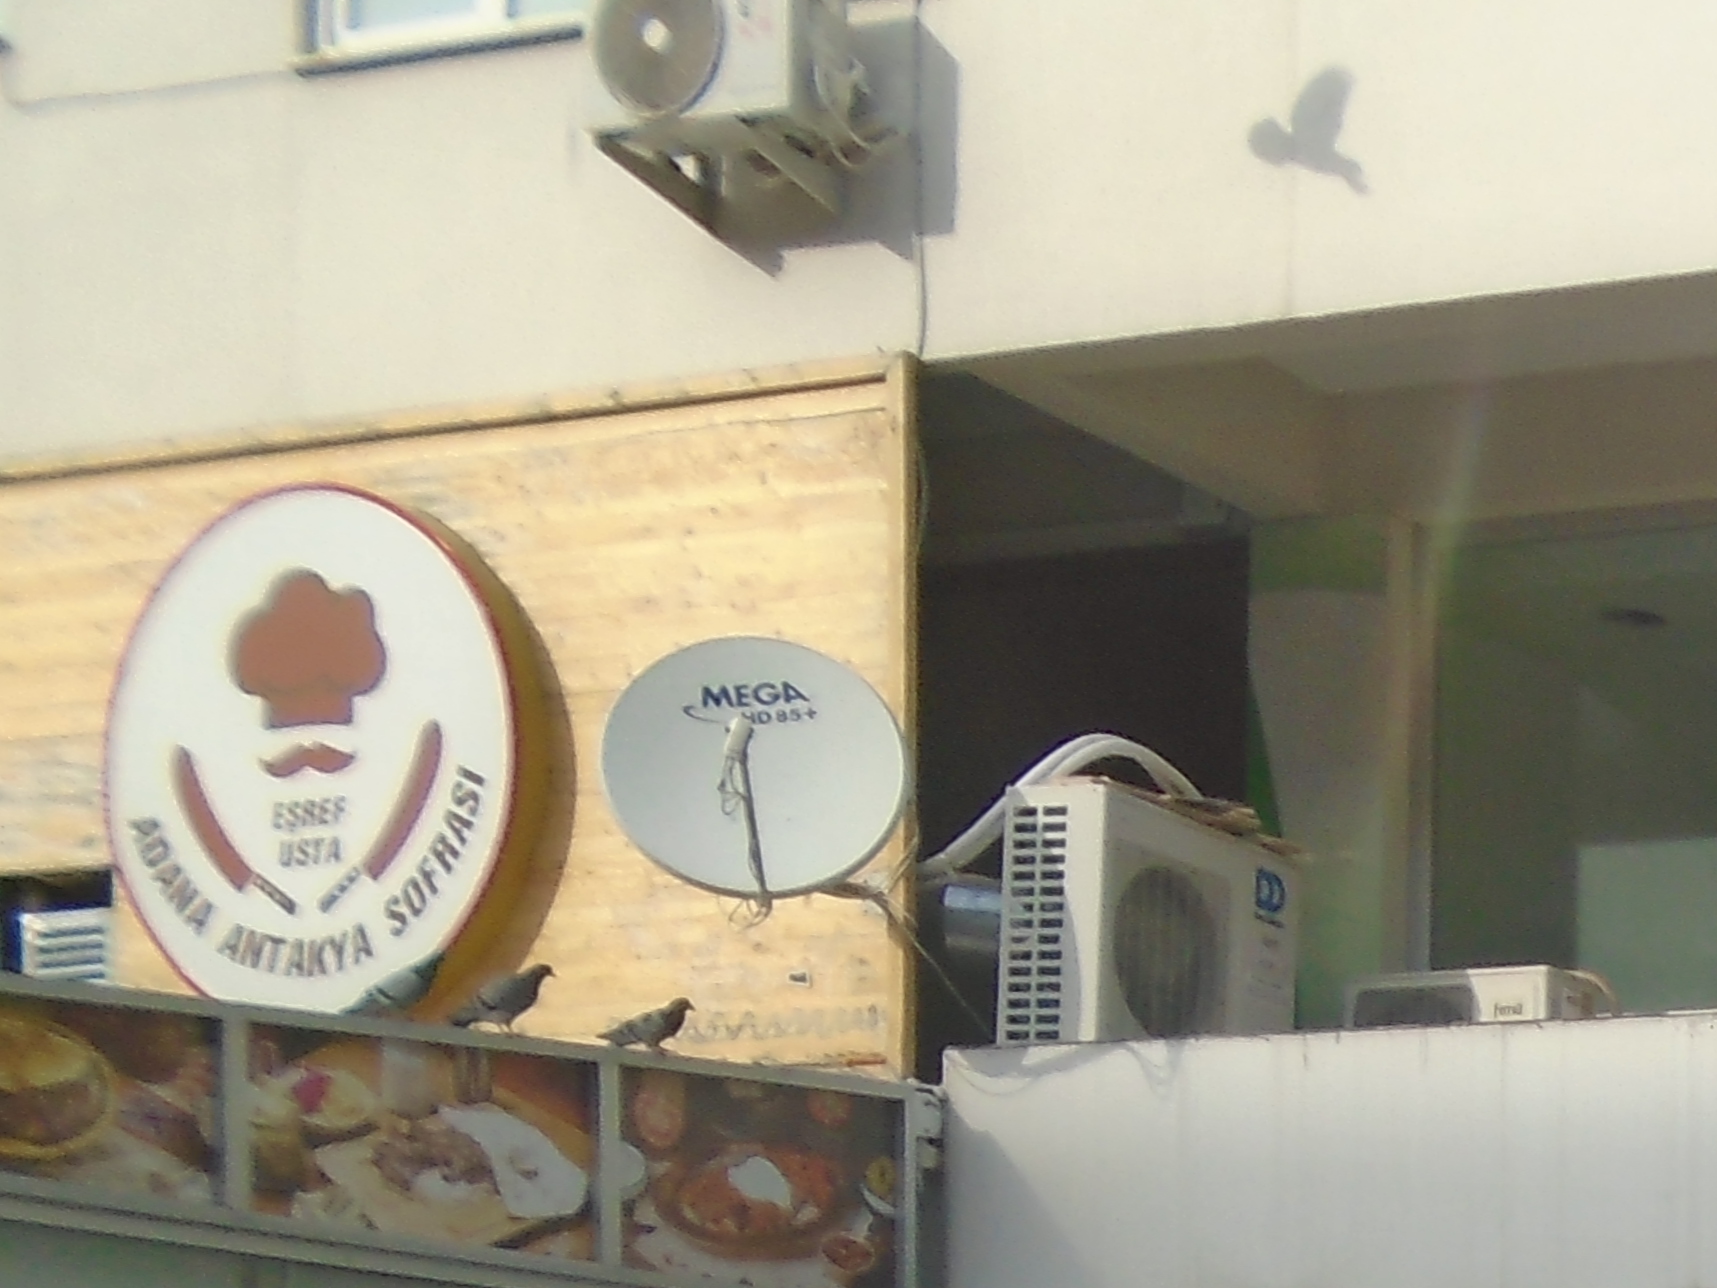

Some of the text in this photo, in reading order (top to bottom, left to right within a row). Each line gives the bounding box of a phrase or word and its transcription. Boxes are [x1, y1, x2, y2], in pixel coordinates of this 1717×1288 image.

[702, 681, 811, 708] MEGA
[279, 837, 342, 867] USTA
[127, 764, 487, 977] ADANA ANTAKYA SOFRASI
